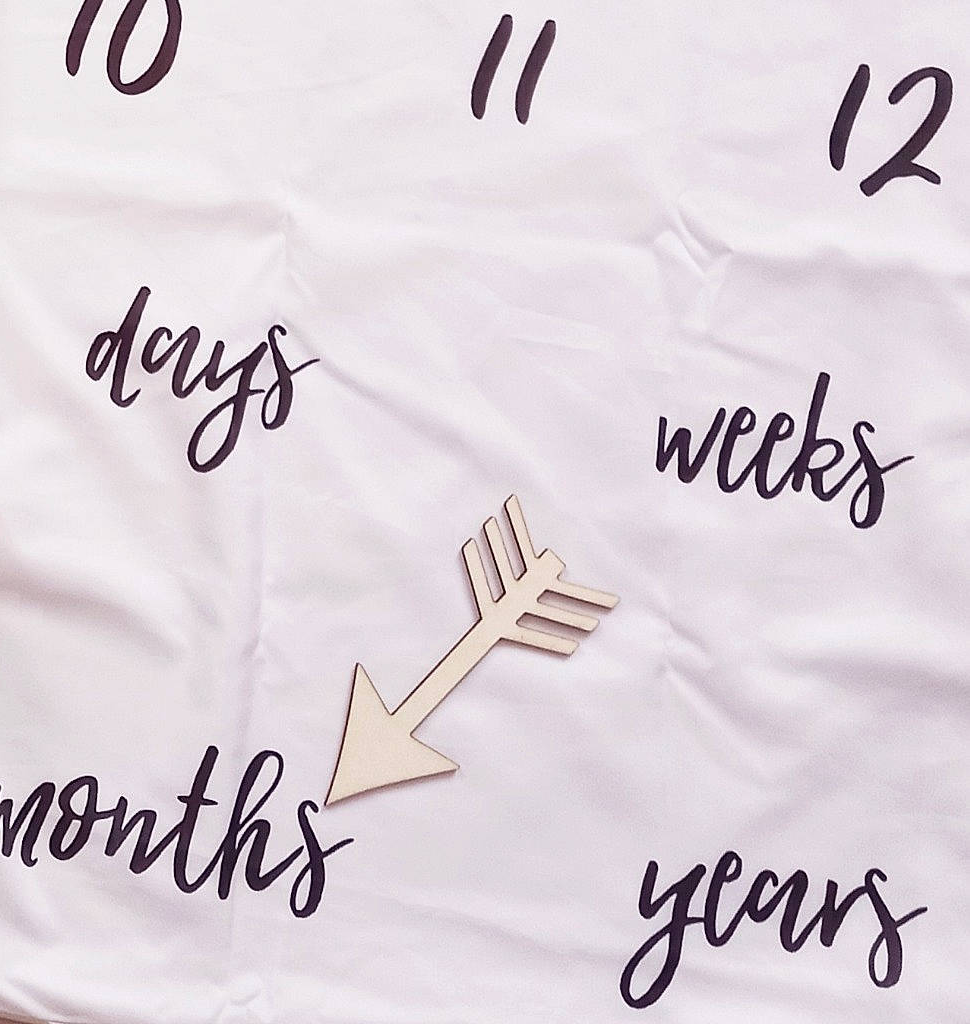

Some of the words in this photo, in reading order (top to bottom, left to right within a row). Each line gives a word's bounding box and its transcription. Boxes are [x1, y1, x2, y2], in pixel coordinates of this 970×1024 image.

[470, 13, 556, 125] 11
[828, 63, 953, 197] 12
[85, 285, 320, 474] days
[655, 371, 915, 529] weeks
[619, 850, 928, 1010] years
